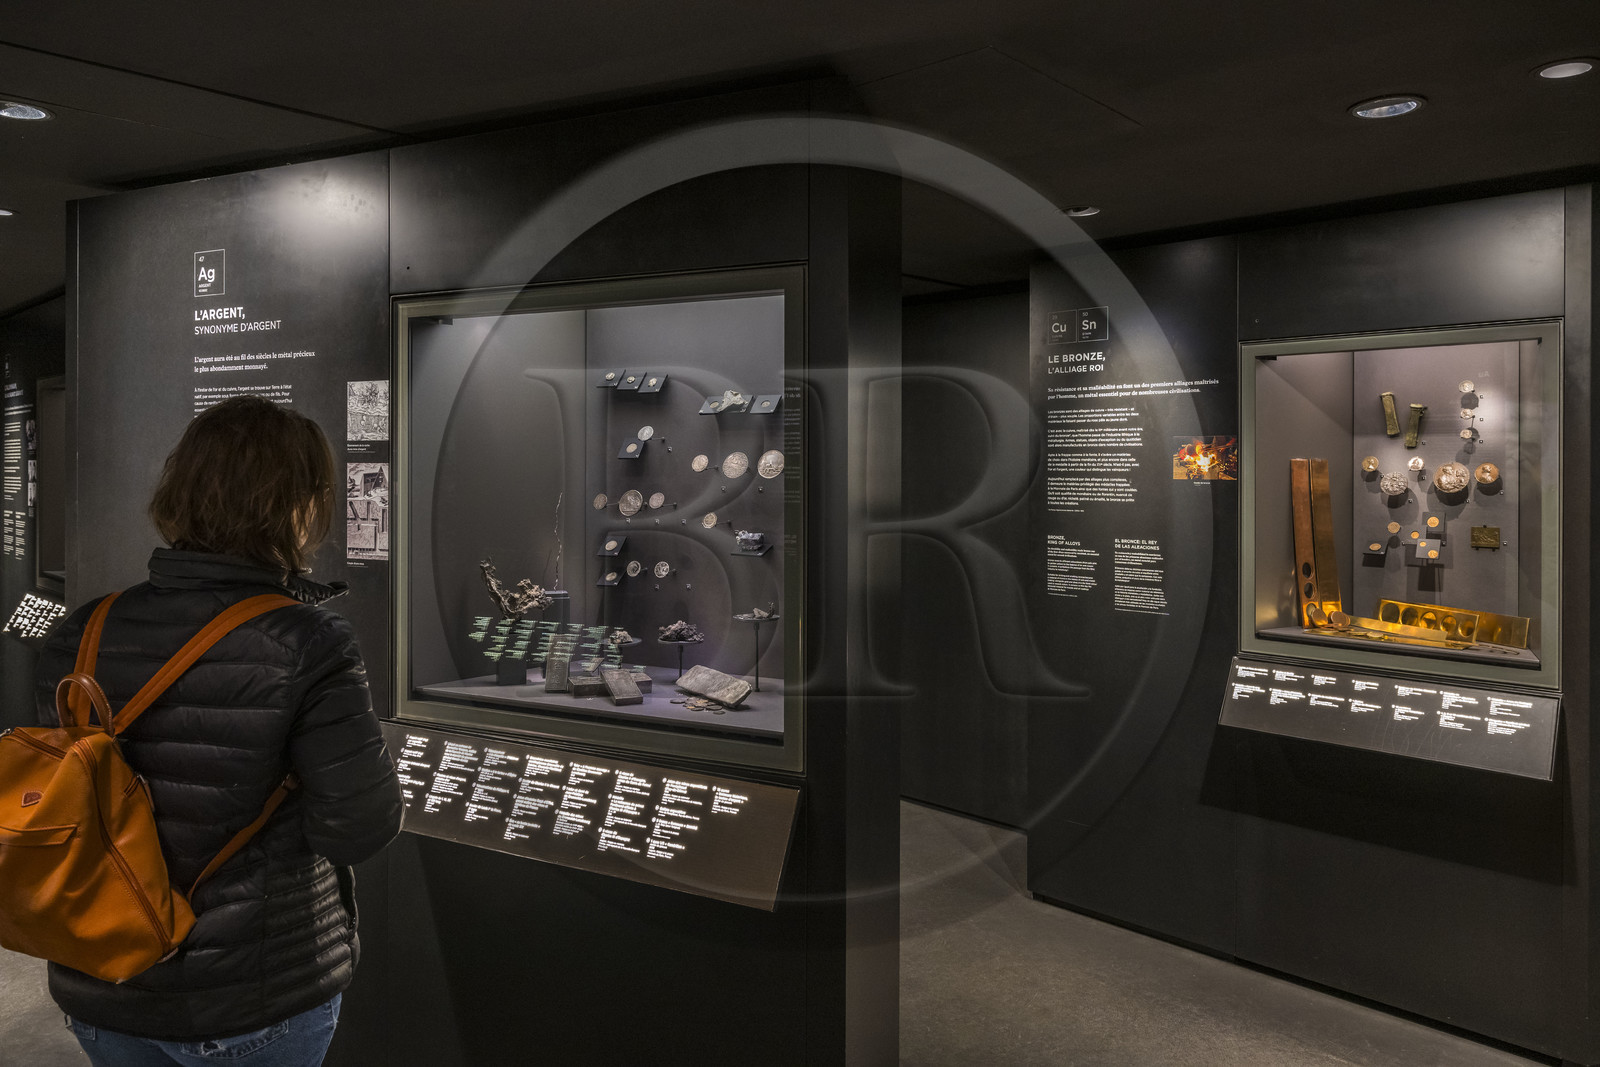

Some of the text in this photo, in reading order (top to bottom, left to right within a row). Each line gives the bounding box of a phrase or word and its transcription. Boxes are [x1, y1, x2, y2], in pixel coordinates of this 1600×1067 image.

[198, 267, 215, 282] Ag
[194, 307, 246, 321] L'ARGENT,
[194, 320, 281, 335] SYNONYME D'ARGENT
[1052, 322, 1066, 333] Cu
[1082, 320, 1096, 330] Sn
[293, 350, 315, 358] précieux
[1048, 351, 1106, 364] LE BRONZE,
[1048, 365, 1087, 374] L'ALLIAGE
